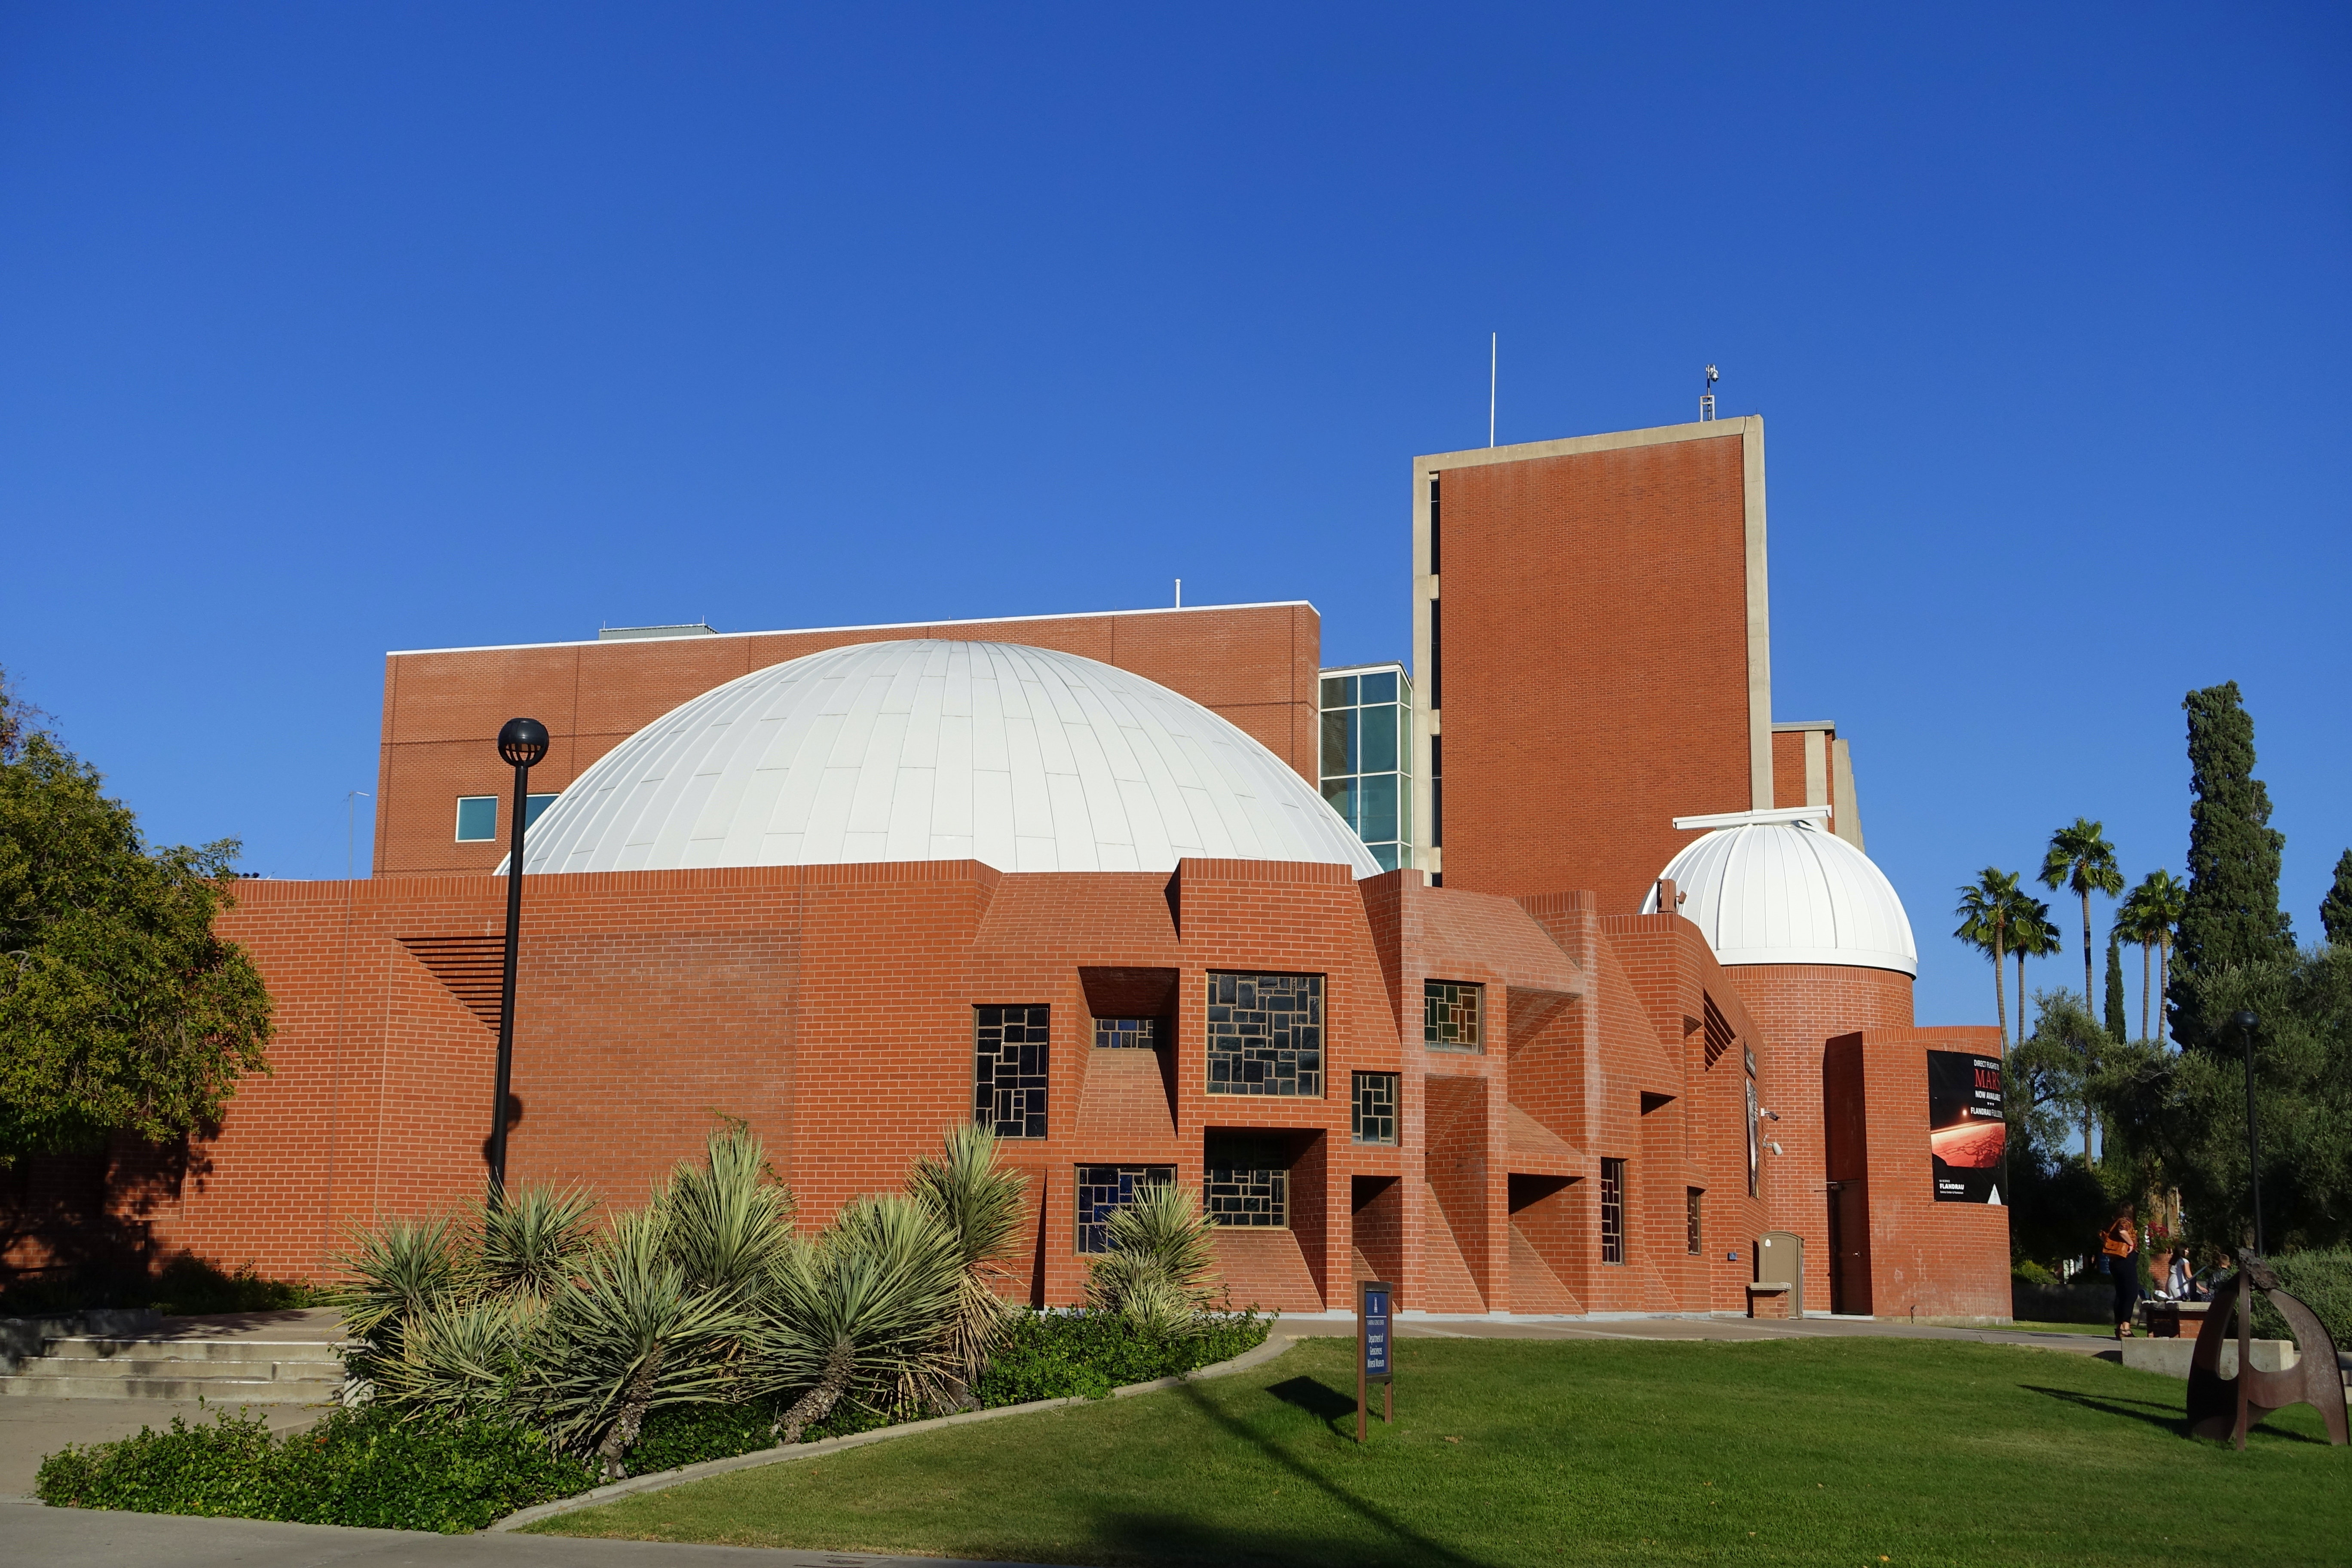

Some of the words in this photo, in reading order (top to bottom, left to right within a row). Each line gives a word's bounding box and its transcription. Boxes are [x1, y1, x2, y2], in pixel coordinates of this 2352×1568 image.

[1975, 1069, 2000, 1090] MARS
[1975, 1090, 1986, 1099] NOW
[1986, 1092, 2001, 1102] AVAILABLE
[1970, 1106, 1991, 1116] FLANDRAU
[1368, 1334, 1381, 1345] Department
[1367, 1358, 1375, 1368] Mineral
[1375, 1358, 1384, 1367] Museum
